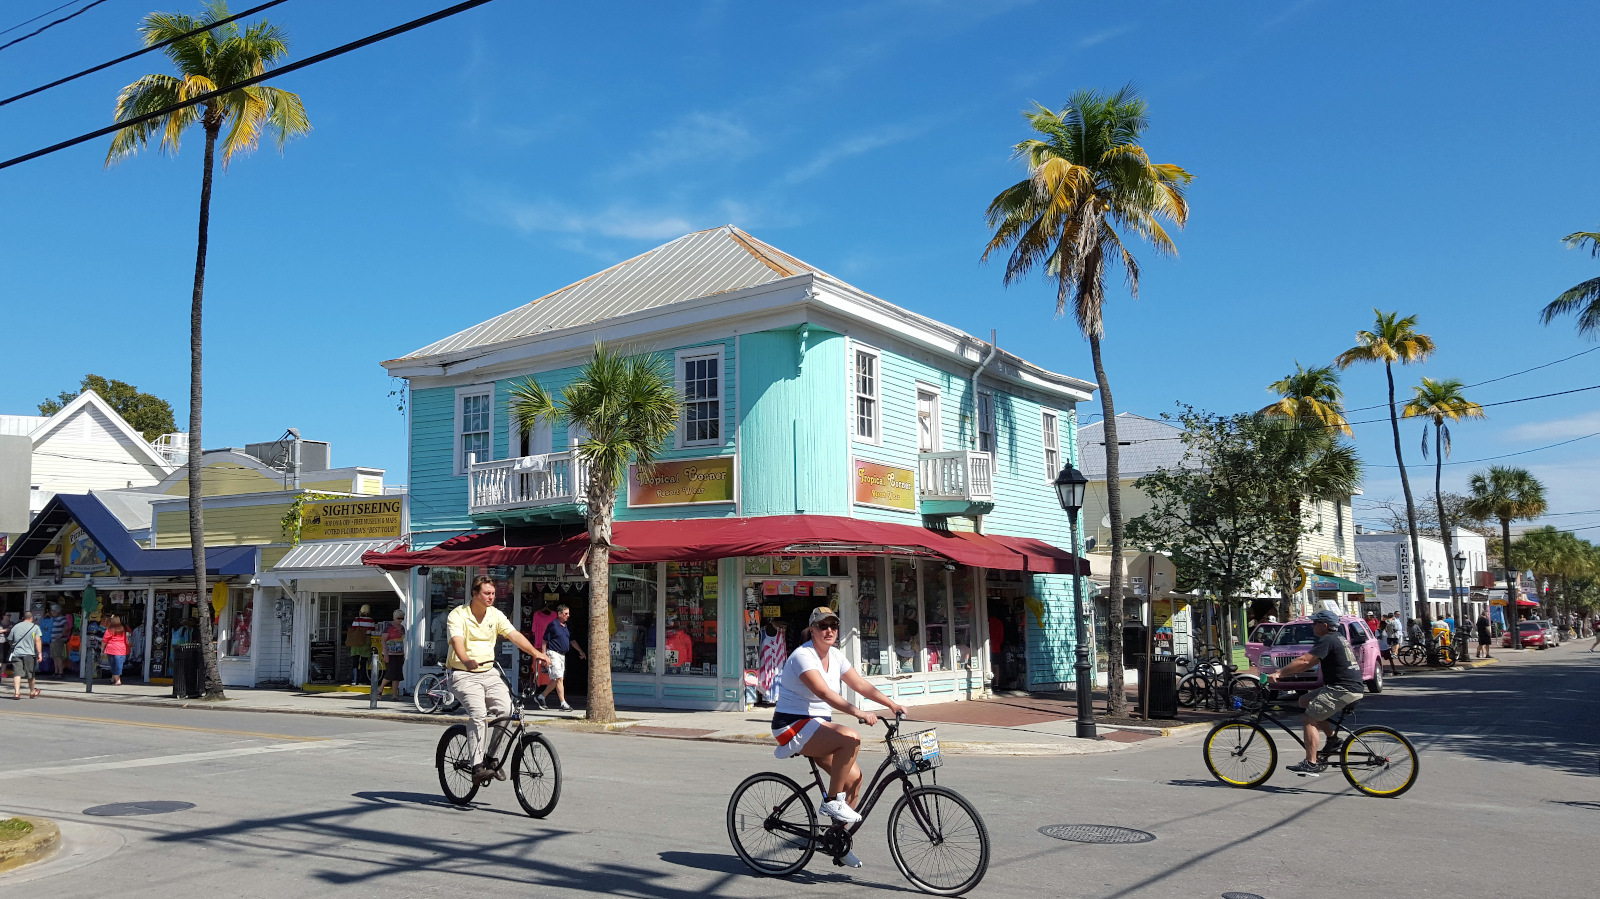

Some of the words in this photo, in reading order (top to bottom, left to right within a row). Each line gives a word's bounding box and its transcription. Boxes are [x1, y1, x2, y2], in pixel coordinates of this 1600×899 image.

[635, 470, 680, 487] Tropical
[683, 465, 727, 481] Corner
[858, 467, 885, 486] Tropical
[887, 471, 911, 490] Corner
[656, 488, 680, 498] Resort
[682, 485, 705, 496] Wear
[322, 502, 400, 516] SIGHTSEEING
[354, 518, 364, 526] FREE
[341, 526, 366, 534] FLORIDA'S
[1400, 543, 1408, 563] KINO
